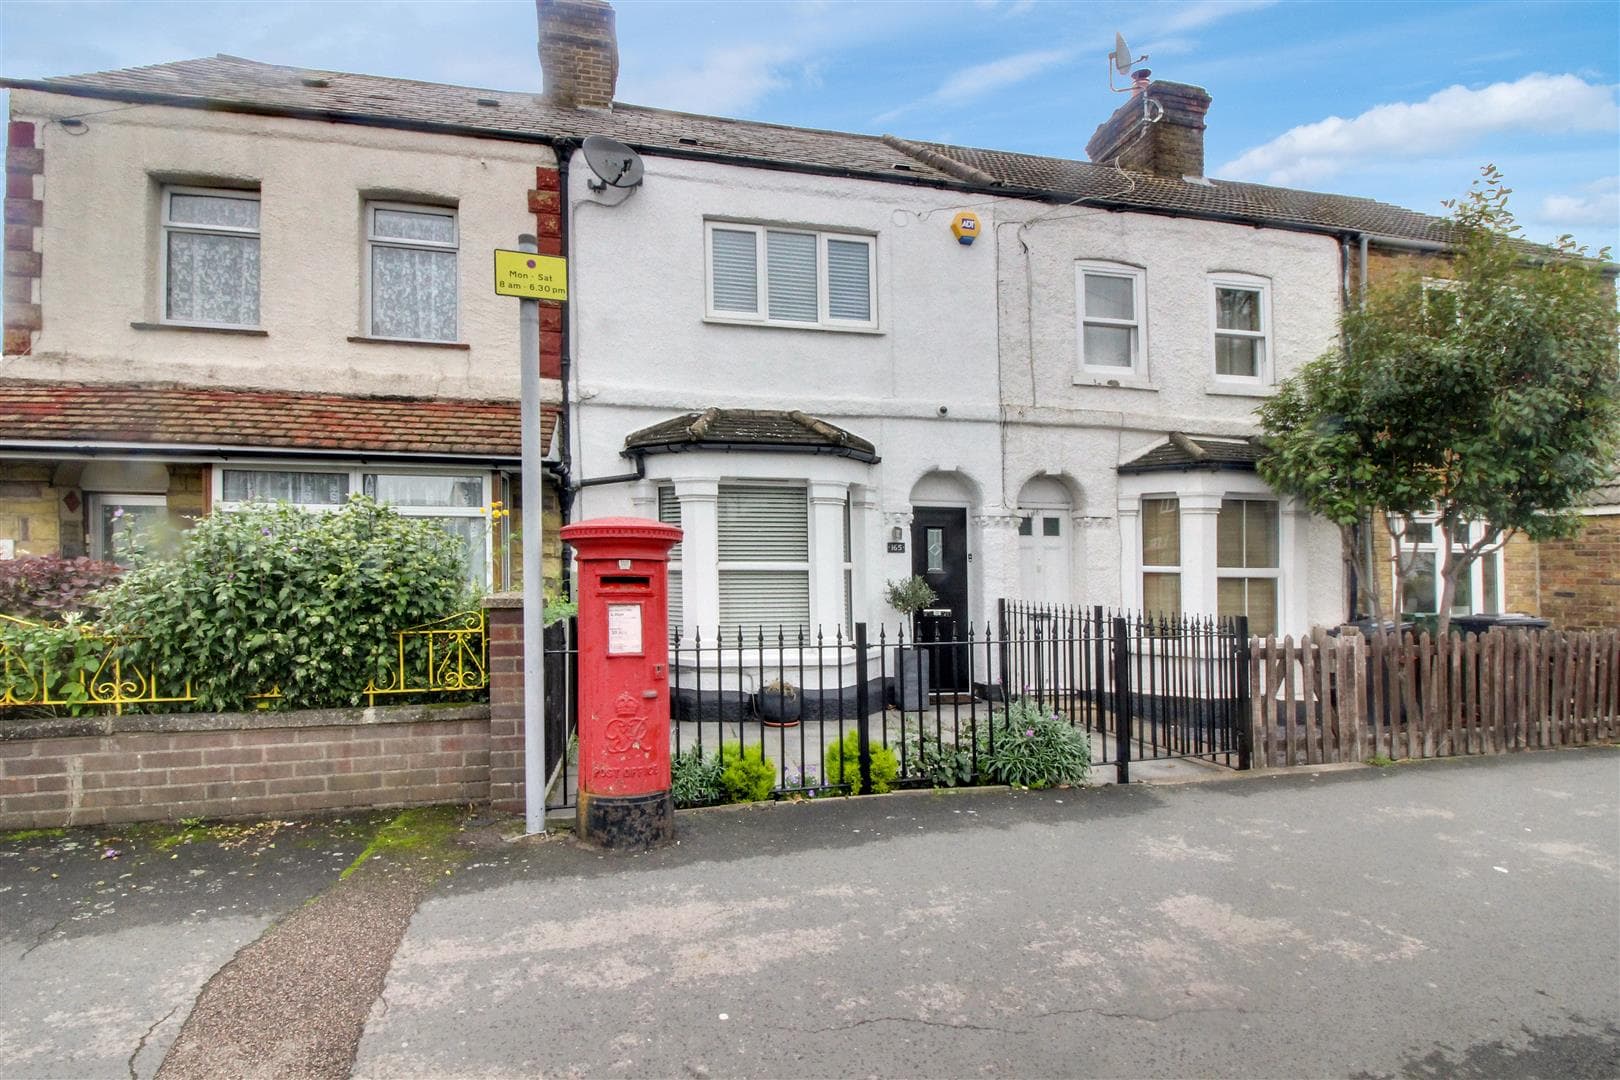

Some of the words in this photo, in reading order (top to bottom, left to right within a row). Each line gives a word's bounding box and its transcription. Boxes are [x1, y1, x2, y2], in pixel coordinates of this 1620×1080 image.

[962, 220, 974, 229] ADT
[509, 270, 529, 279] Mon
[538, 273, 553, 282] Sat
[499, 280, 505, 288] 8
[529, 283, 551, 292] 6.30
[592, 765, 621, 778] POST
